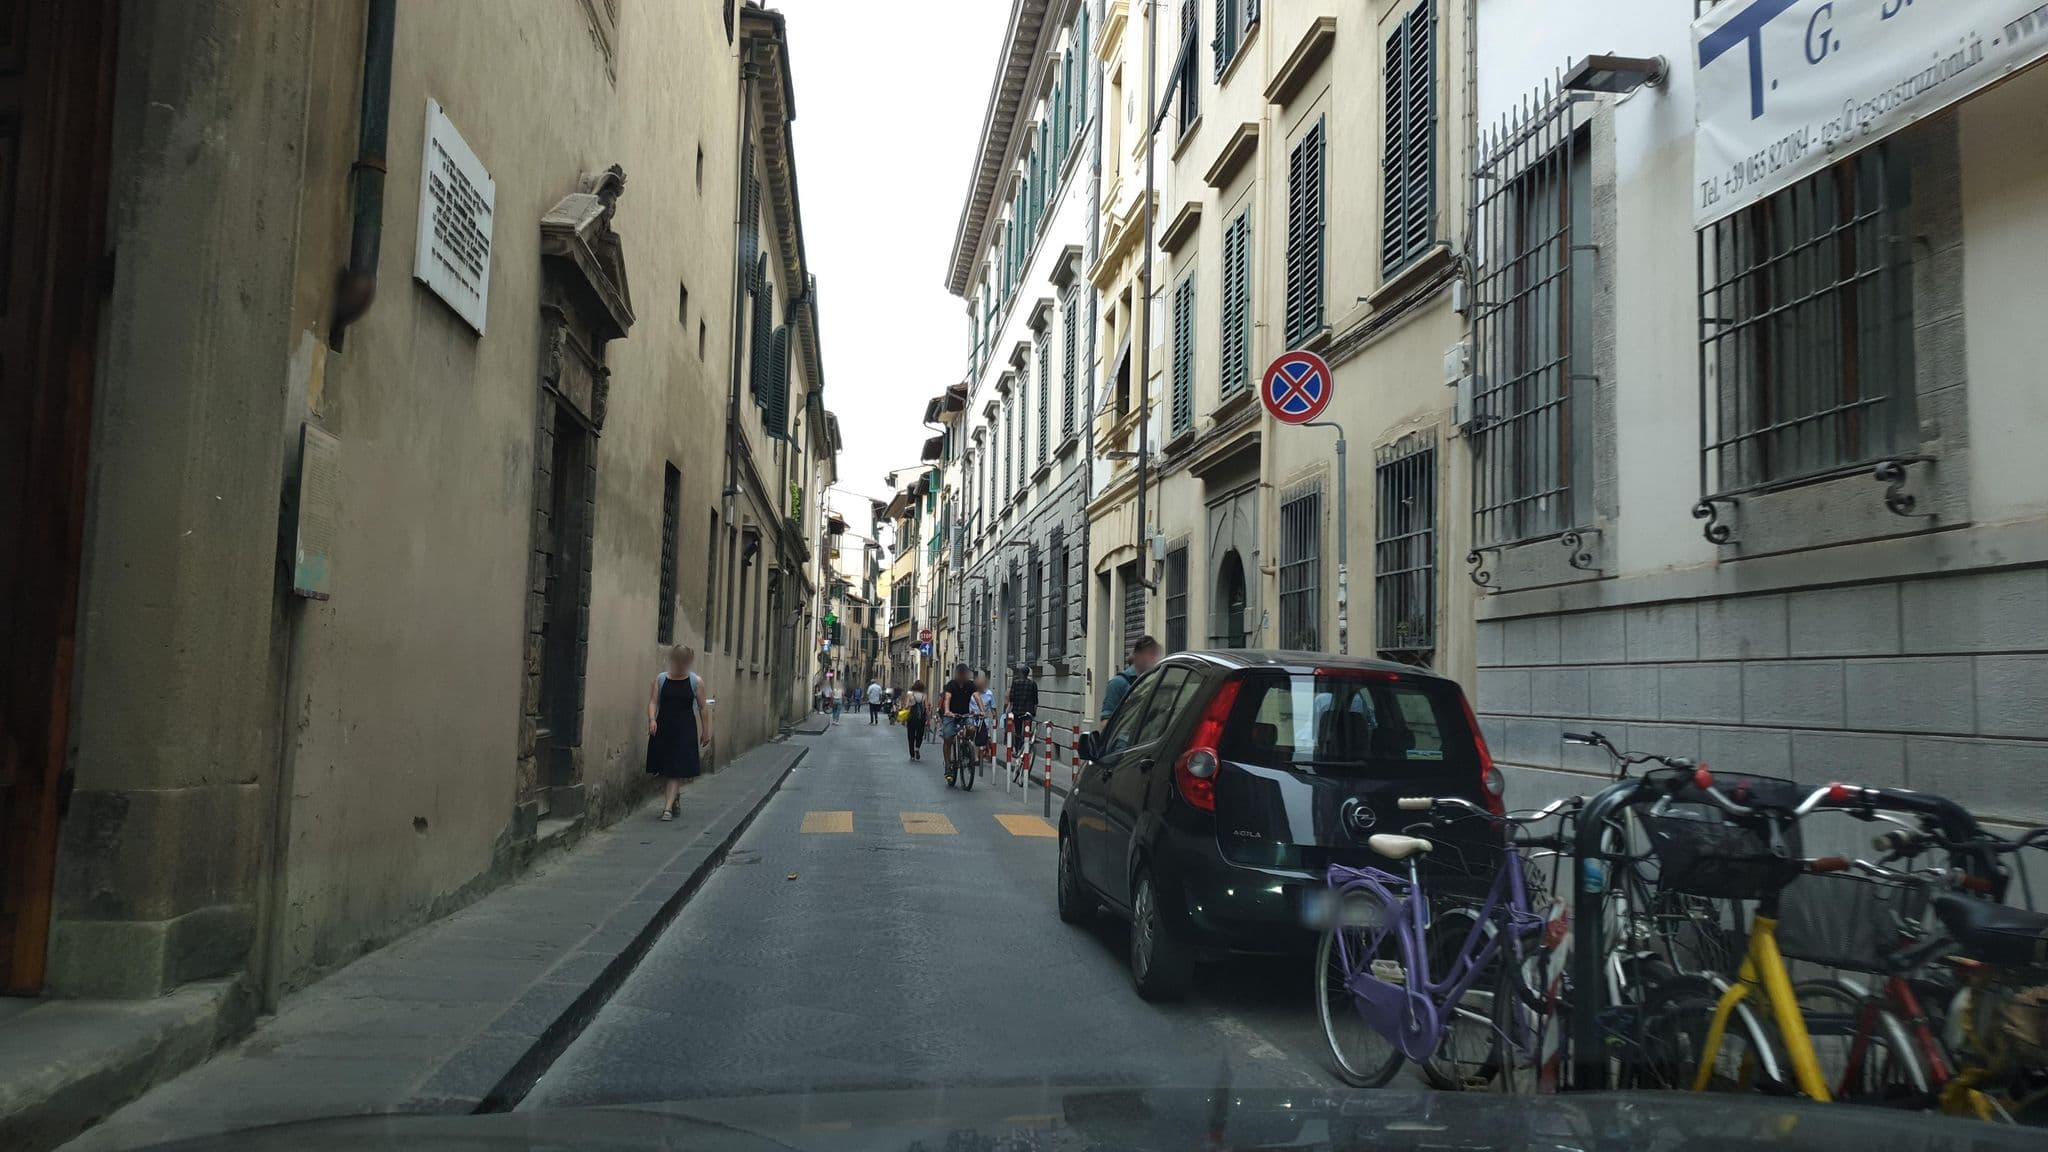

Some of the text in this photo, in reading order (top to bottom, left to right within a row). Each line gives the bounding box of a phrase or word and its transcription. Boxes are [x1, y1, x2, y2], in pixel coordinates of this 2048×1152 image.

[1805, 2, 1840, 65] G.
[1724, 161, 1745, 194] +39
[1746, 151, 1768, 185] 055
